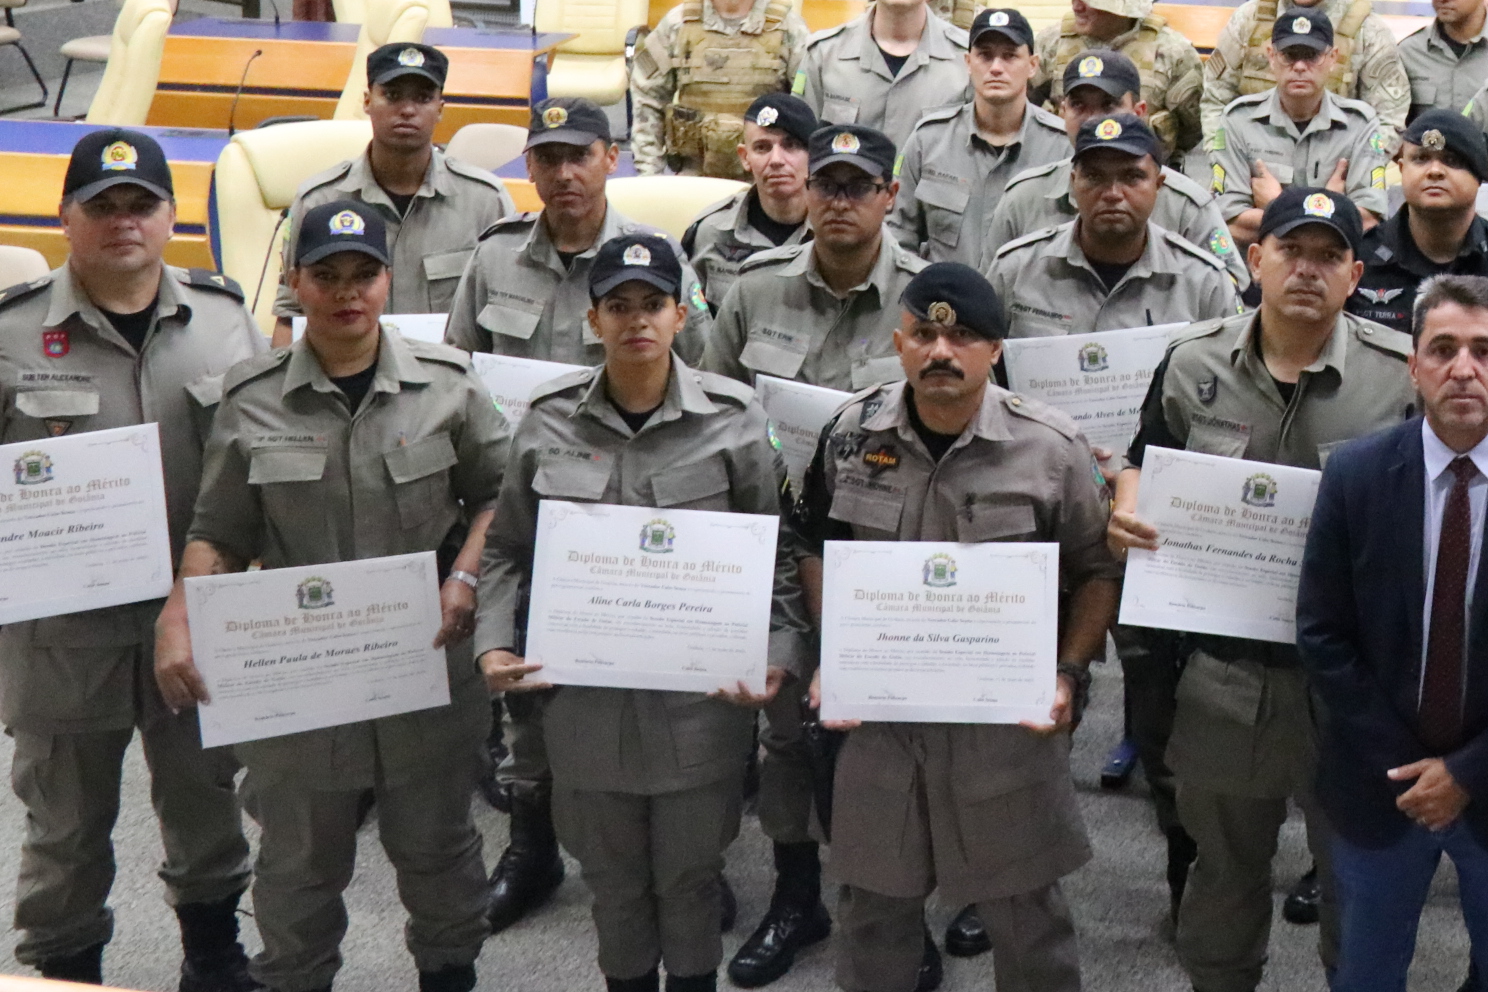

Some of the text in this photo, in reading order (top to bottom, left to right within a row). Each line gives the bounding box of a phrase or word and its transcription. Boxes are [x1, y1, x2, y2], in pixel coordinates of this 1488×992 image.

[495, 395, 528, 408] Diplom
[866, 453, 896, 464] ROTAM
[66, 485, 81, 494] ao
[86, 477, 130, 493] Mérito
[1170, 496, 1220, 515] Diploma
[1224, 507, 1236, 517] de
[1282, 516, 1294, 526] ao
[28, 526, 64, 538] Moacir
[68, 522, 104, 534] Ribeiro
[1162, 537, 1298, 567] Jonathas Fernandes da Rocha
[567, 551, 742, 574] Diploma de Honra ao Mérito
[588, 596, 712, 613] Aline Carla Borges Pereira
[854, 589, 1026, 604] Diploma de Honra ao Mérito
[284, 616, 298, 626] de
[347, 608, 362, 618] ao
[876, 632, 1000, 645] Jhonne da Silva Gasparino
[243, 640, 398, 670] Hellen Paula de Moraes Ribeiro
